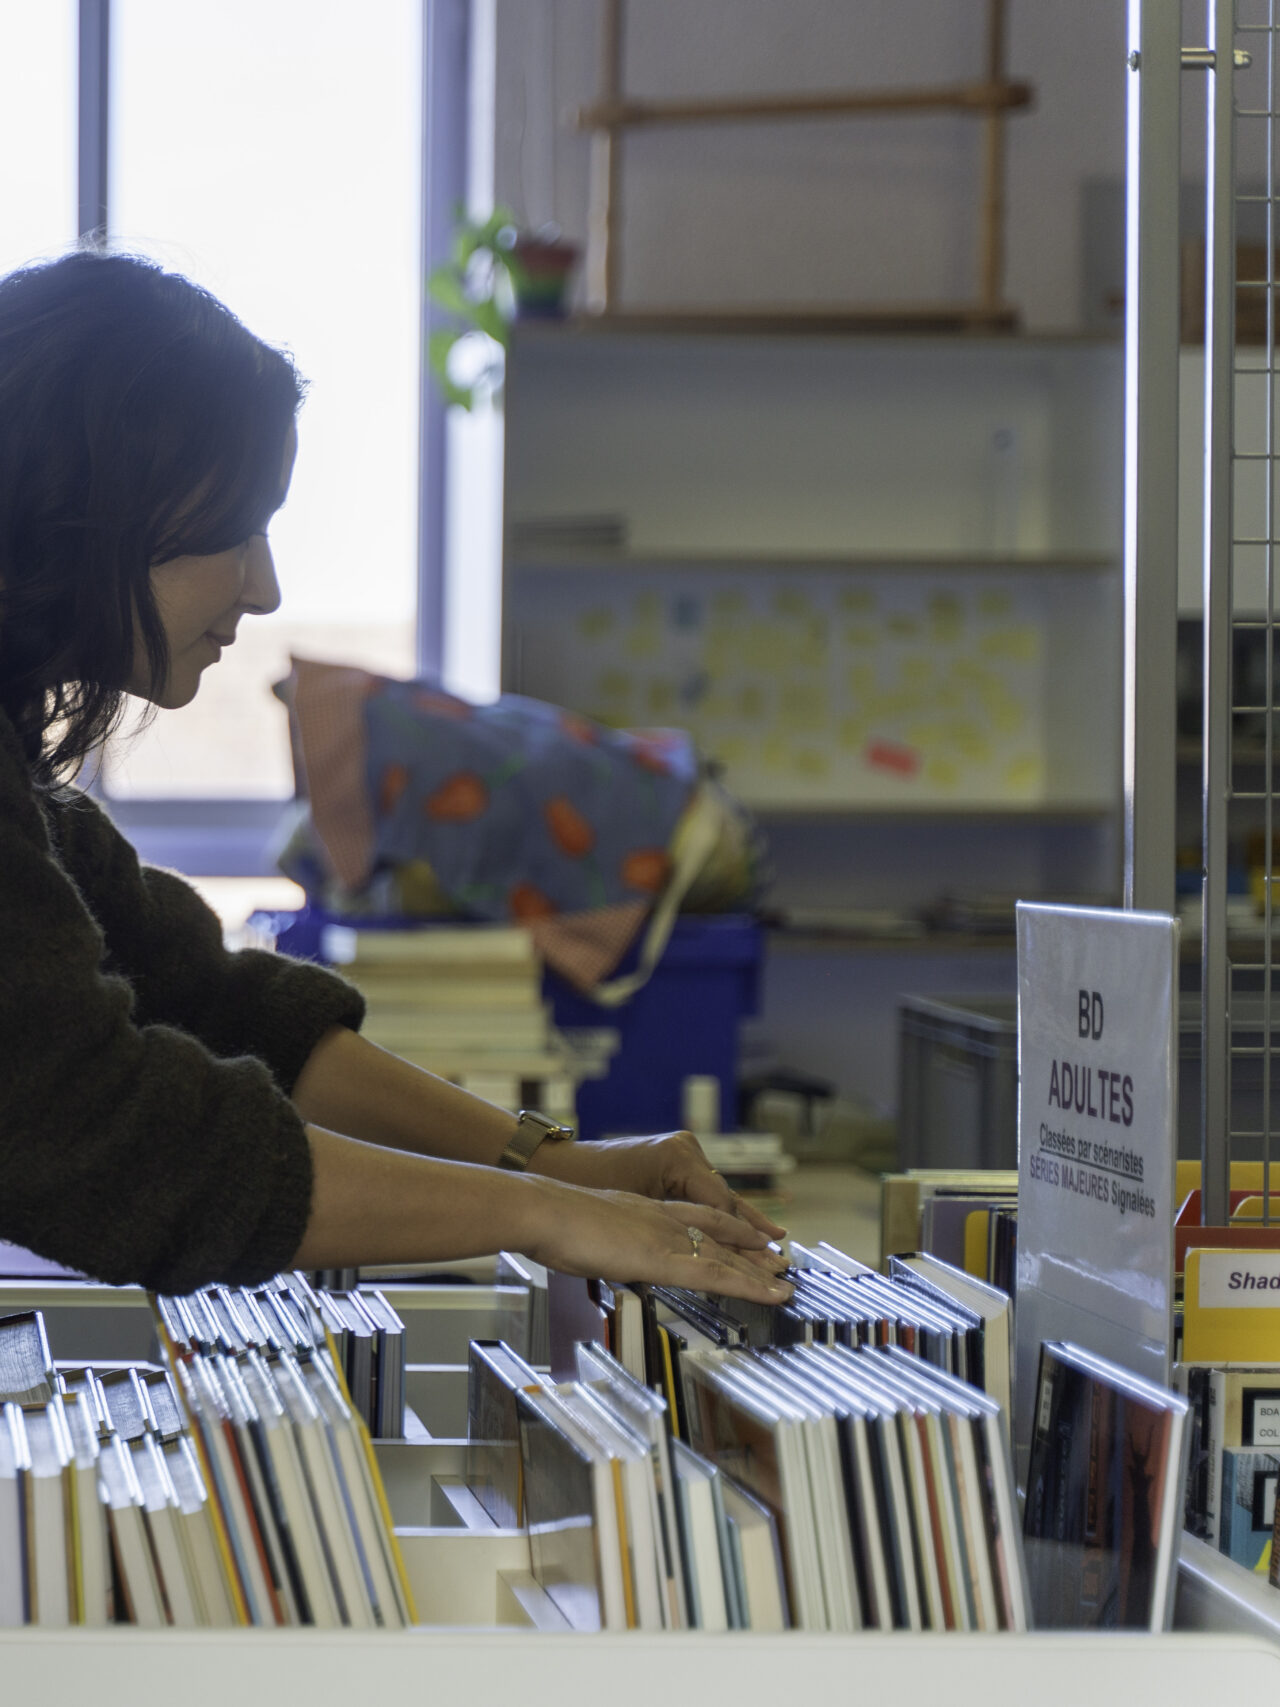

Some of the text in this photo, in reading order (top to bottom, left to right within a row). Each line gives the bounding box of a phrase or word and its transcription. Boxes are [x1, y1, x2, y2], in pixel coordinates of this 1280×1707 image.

[1078, 989, 1104, 1041] BD
[1047, 1059, 1134, 1127] ADULTES
[1040, 1122, 1144, 1176] Classées par scénaristes
[1061, 1164, 1109, 1203] MAJEURES
[1111, 1179, 1156, 1218] Signalées
[1260, 1407, 1280, 1417] BDA
